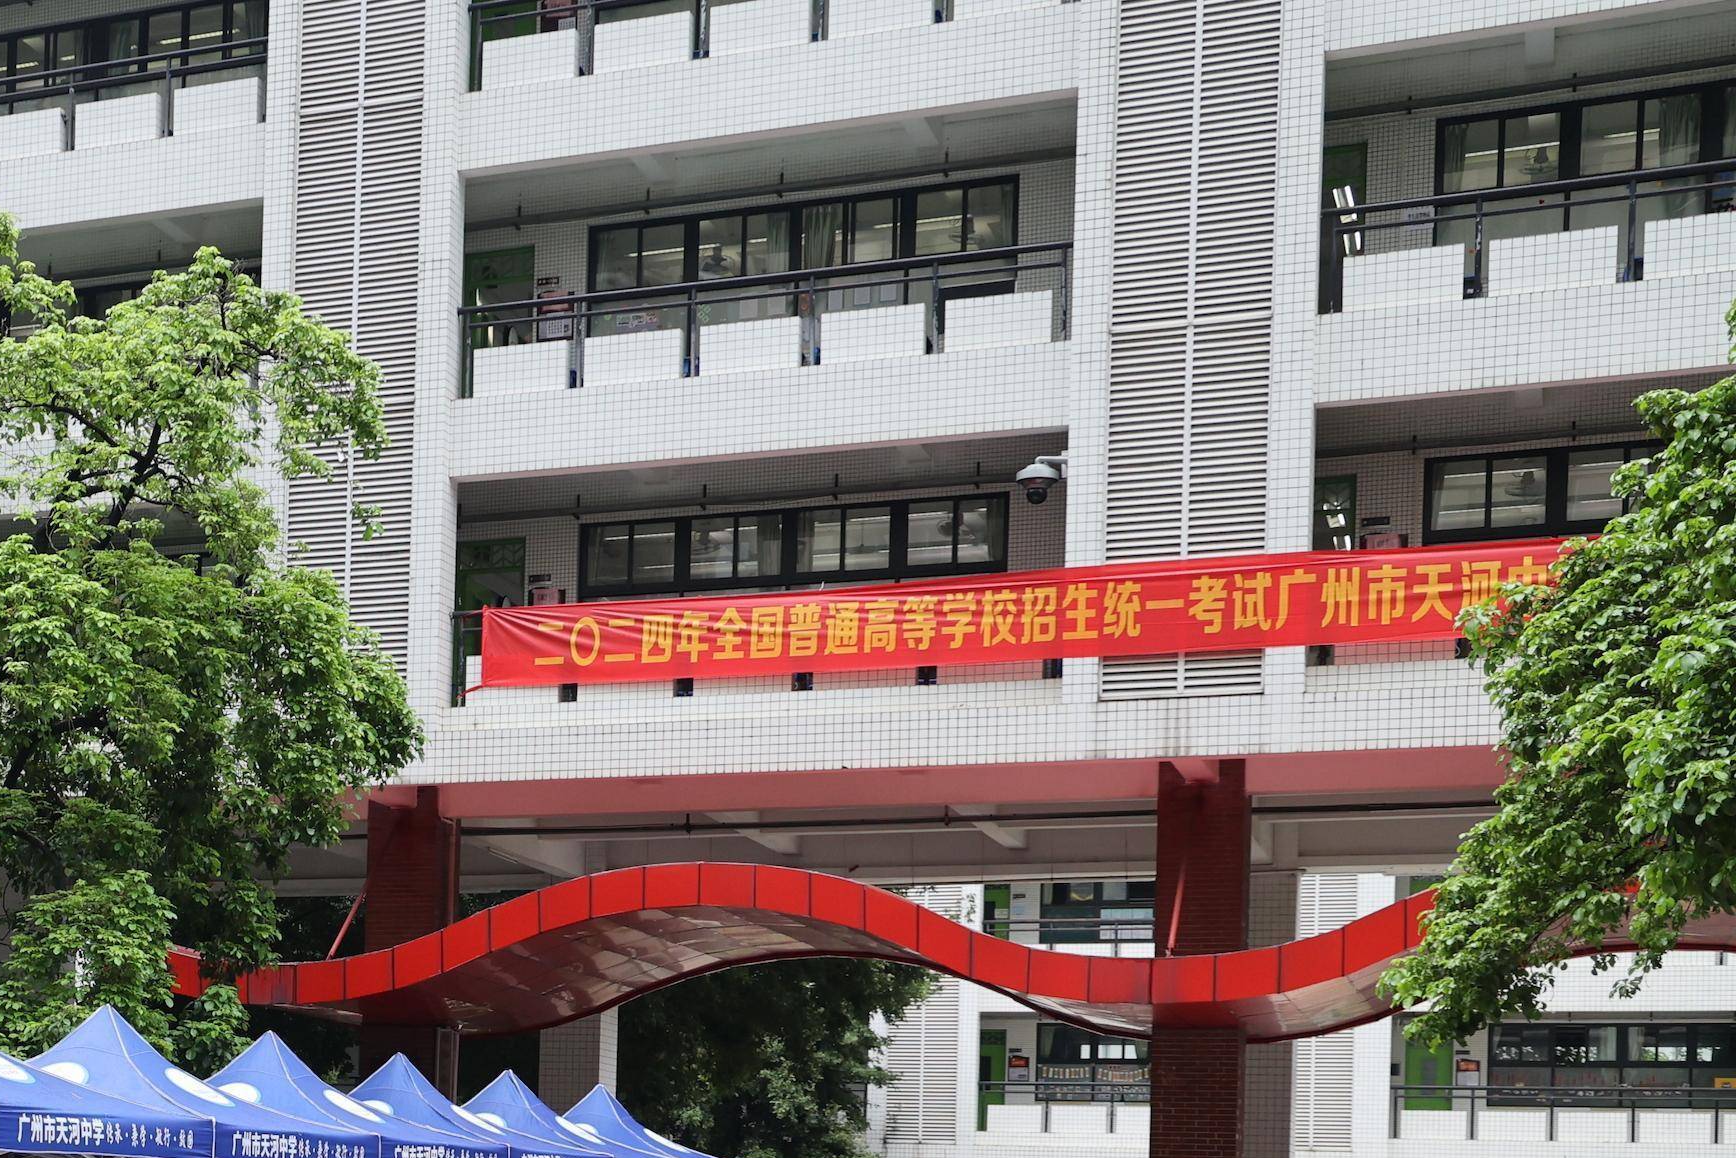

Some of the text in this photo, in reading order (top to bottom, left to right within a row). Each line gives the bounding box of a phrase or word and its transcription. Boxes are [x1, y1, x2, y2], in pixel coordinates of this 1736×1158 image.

[534, 554, 1569, 667] 二〇二四年全国普通高等学校招生统一考试广州市天河中
[17, 1113, 105, 1147] 广州市天河中学
